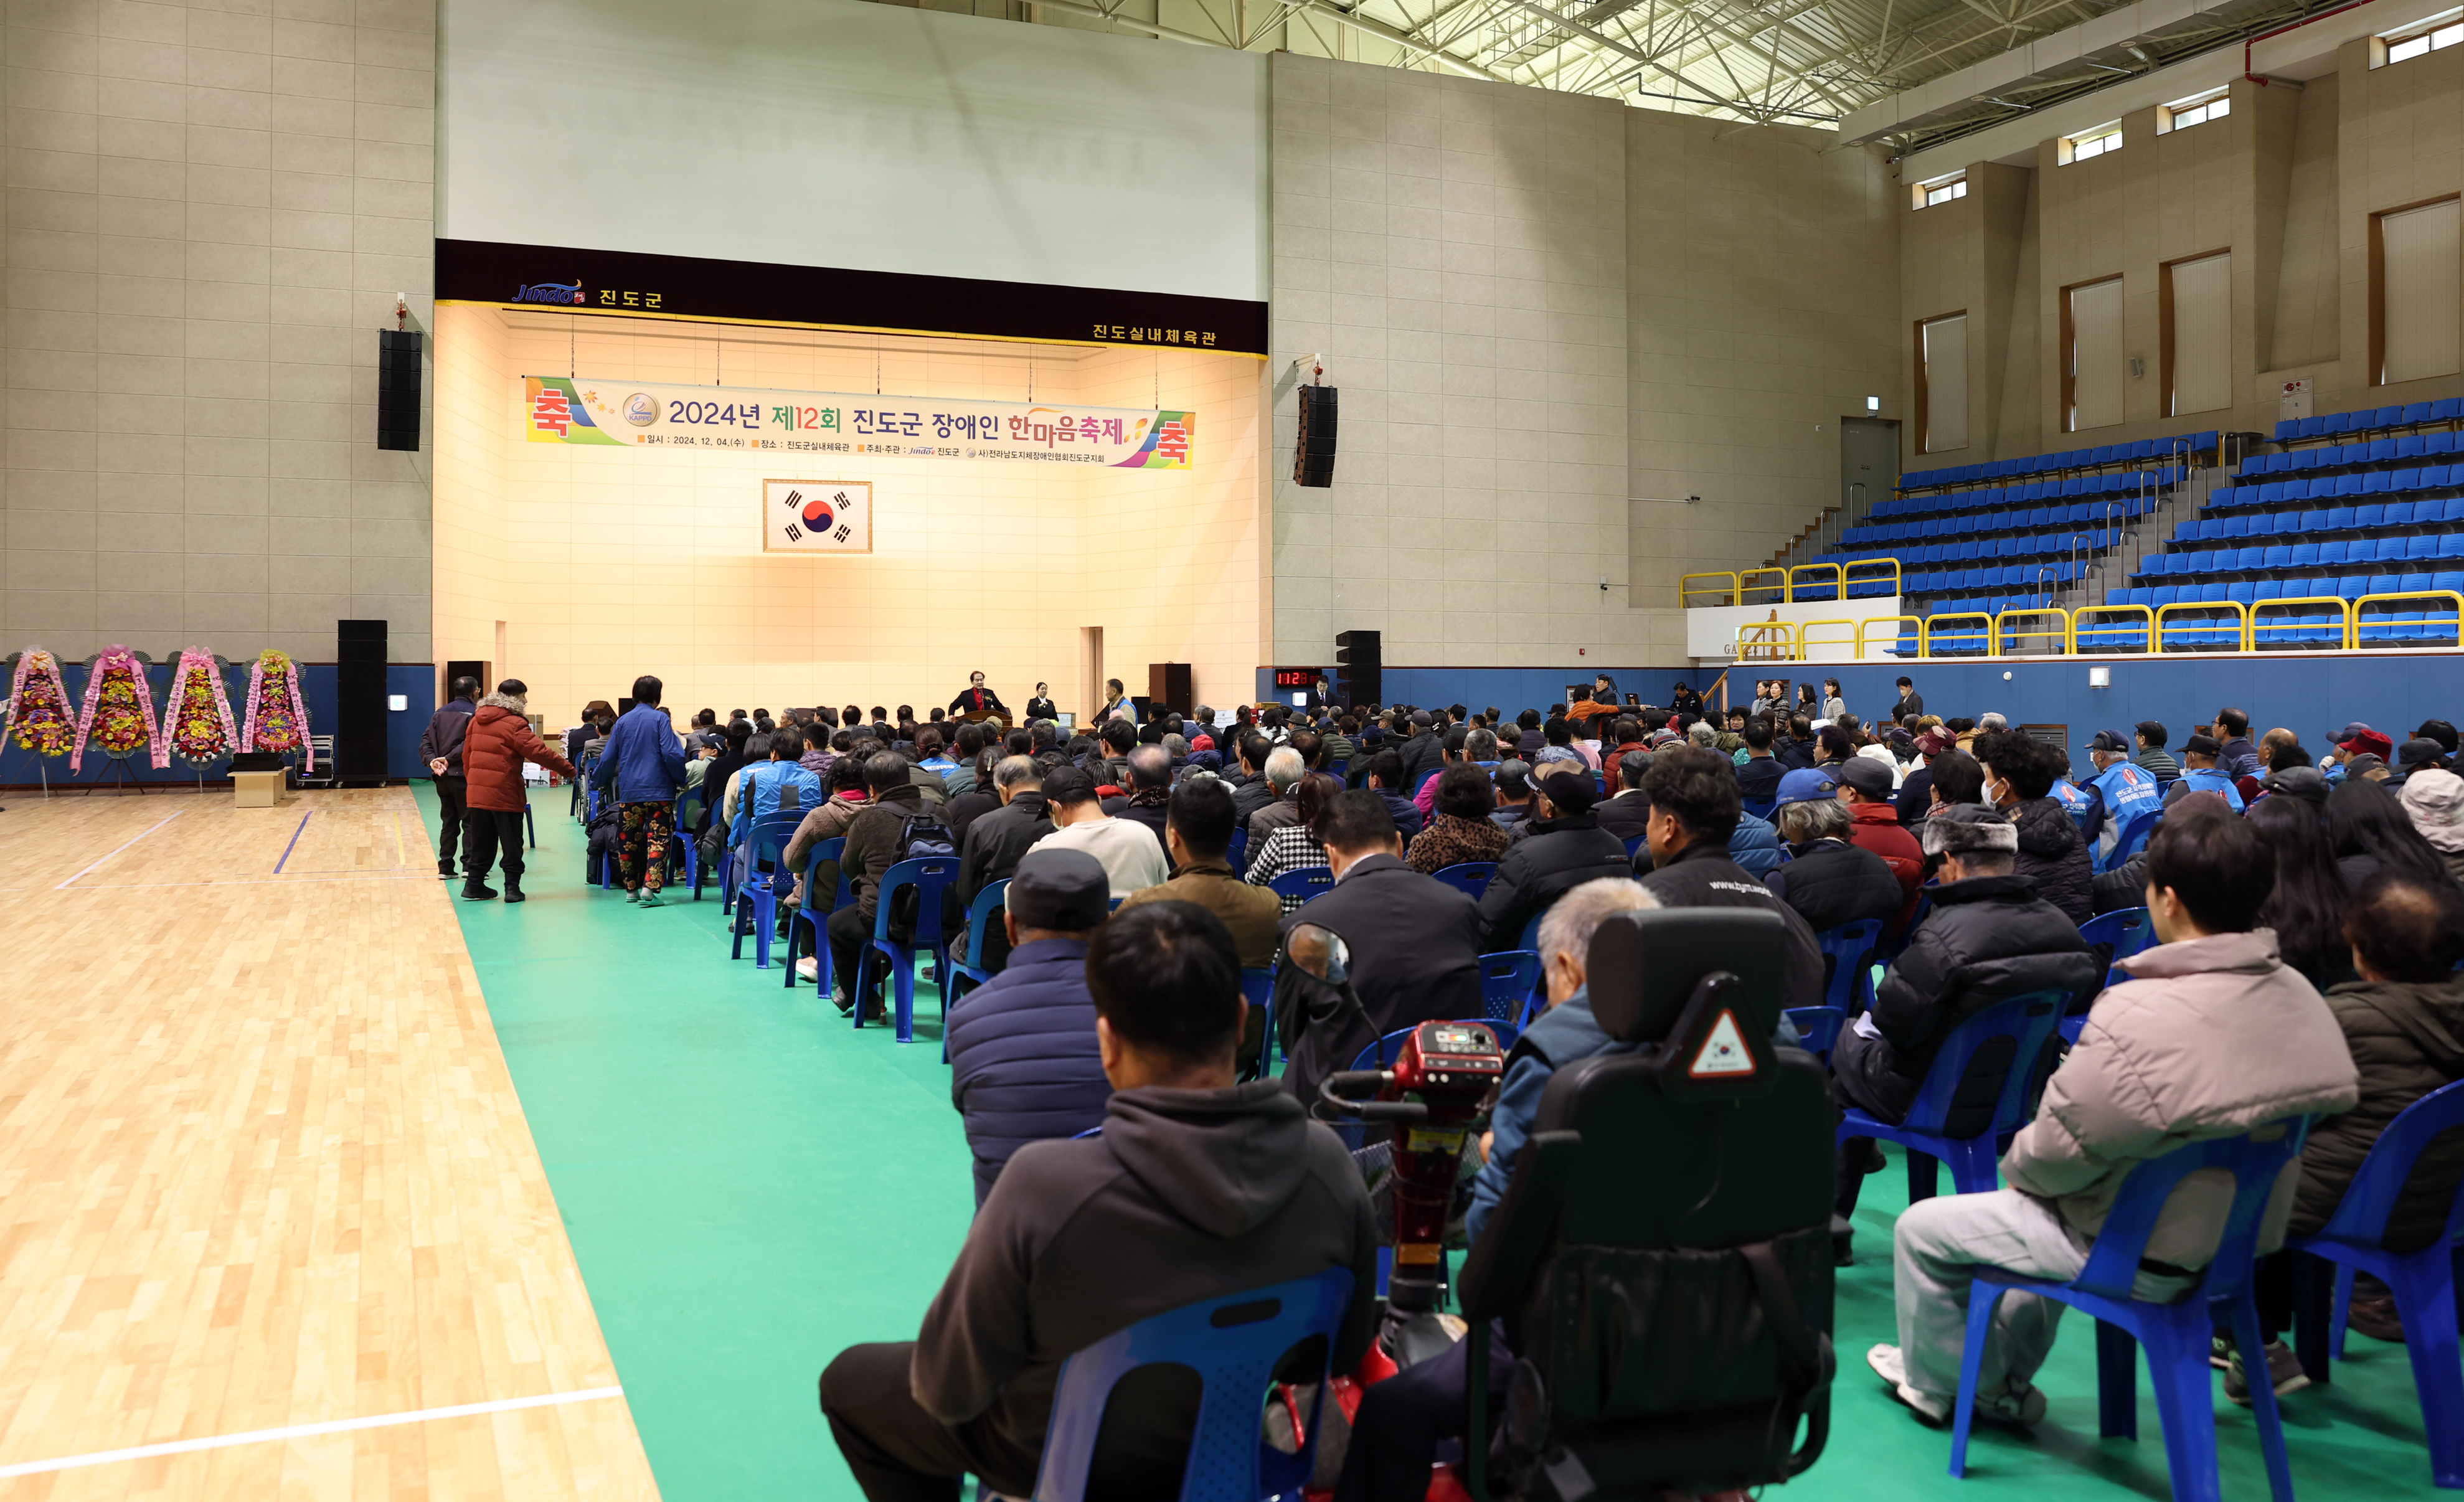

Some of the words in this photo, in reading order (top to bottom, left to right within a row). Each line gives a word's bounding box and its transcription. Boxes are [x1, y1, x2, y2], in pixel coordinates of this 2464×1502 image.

[511, 284, 574, 303] Jindo
[600, 290, 662, 308] 진도군
[1093, 324, 1216, 346] 진도실내체육관
[533, 390, 571, 437] 축
[669, 400, 760, 429] 2024년
[772, 405, 841, 433] 제12회
[853, 410, 923, 436] 진도군
[932, 413, 998, 440] 장애인
[1008, 415, 1122, 449] 한마음축제
[647, 435, 663, 444] 일시
[674, 437, 697, 445] 2024.
[701, 438, 712, 446] 12.
[717, 438, 745, 447] 04.(수)
[761, 440, 776, 449] 장소
[787, 442, 849, 451] 진도군실내체육관
[866, 444, 900, 454] 주최·주관
[937, 447, 960, 456] 진도군
[1157, 422, 1189, 464] 축
[2115, 786, 2133, 797] 진도군
